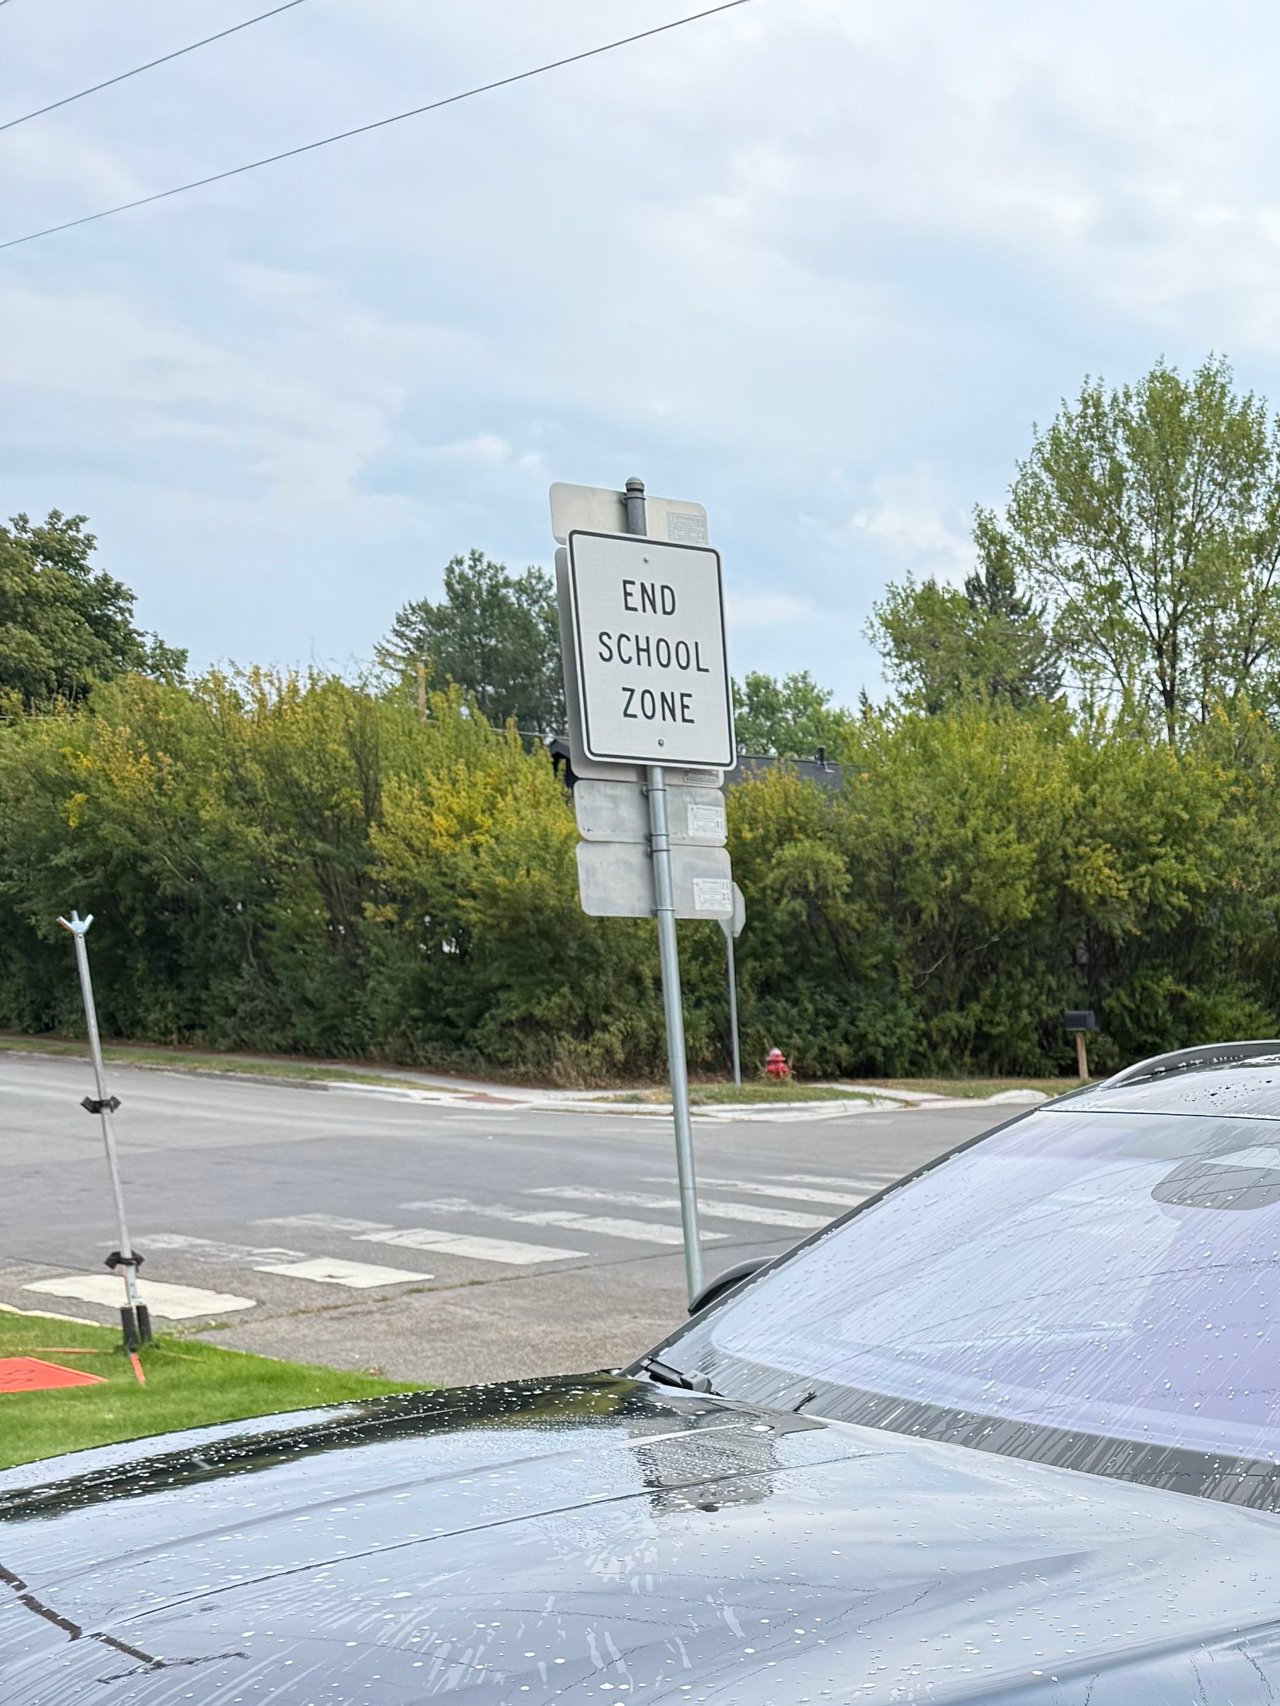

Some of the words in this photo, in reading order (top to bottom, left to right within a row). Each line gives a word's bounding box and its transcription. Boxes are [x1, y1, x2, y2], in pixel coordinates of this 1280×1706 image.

[622, 579, 676, 616] END
[598, 631, 710, 673] SCHOOL
[621, 686, 695, 724] ZONE
